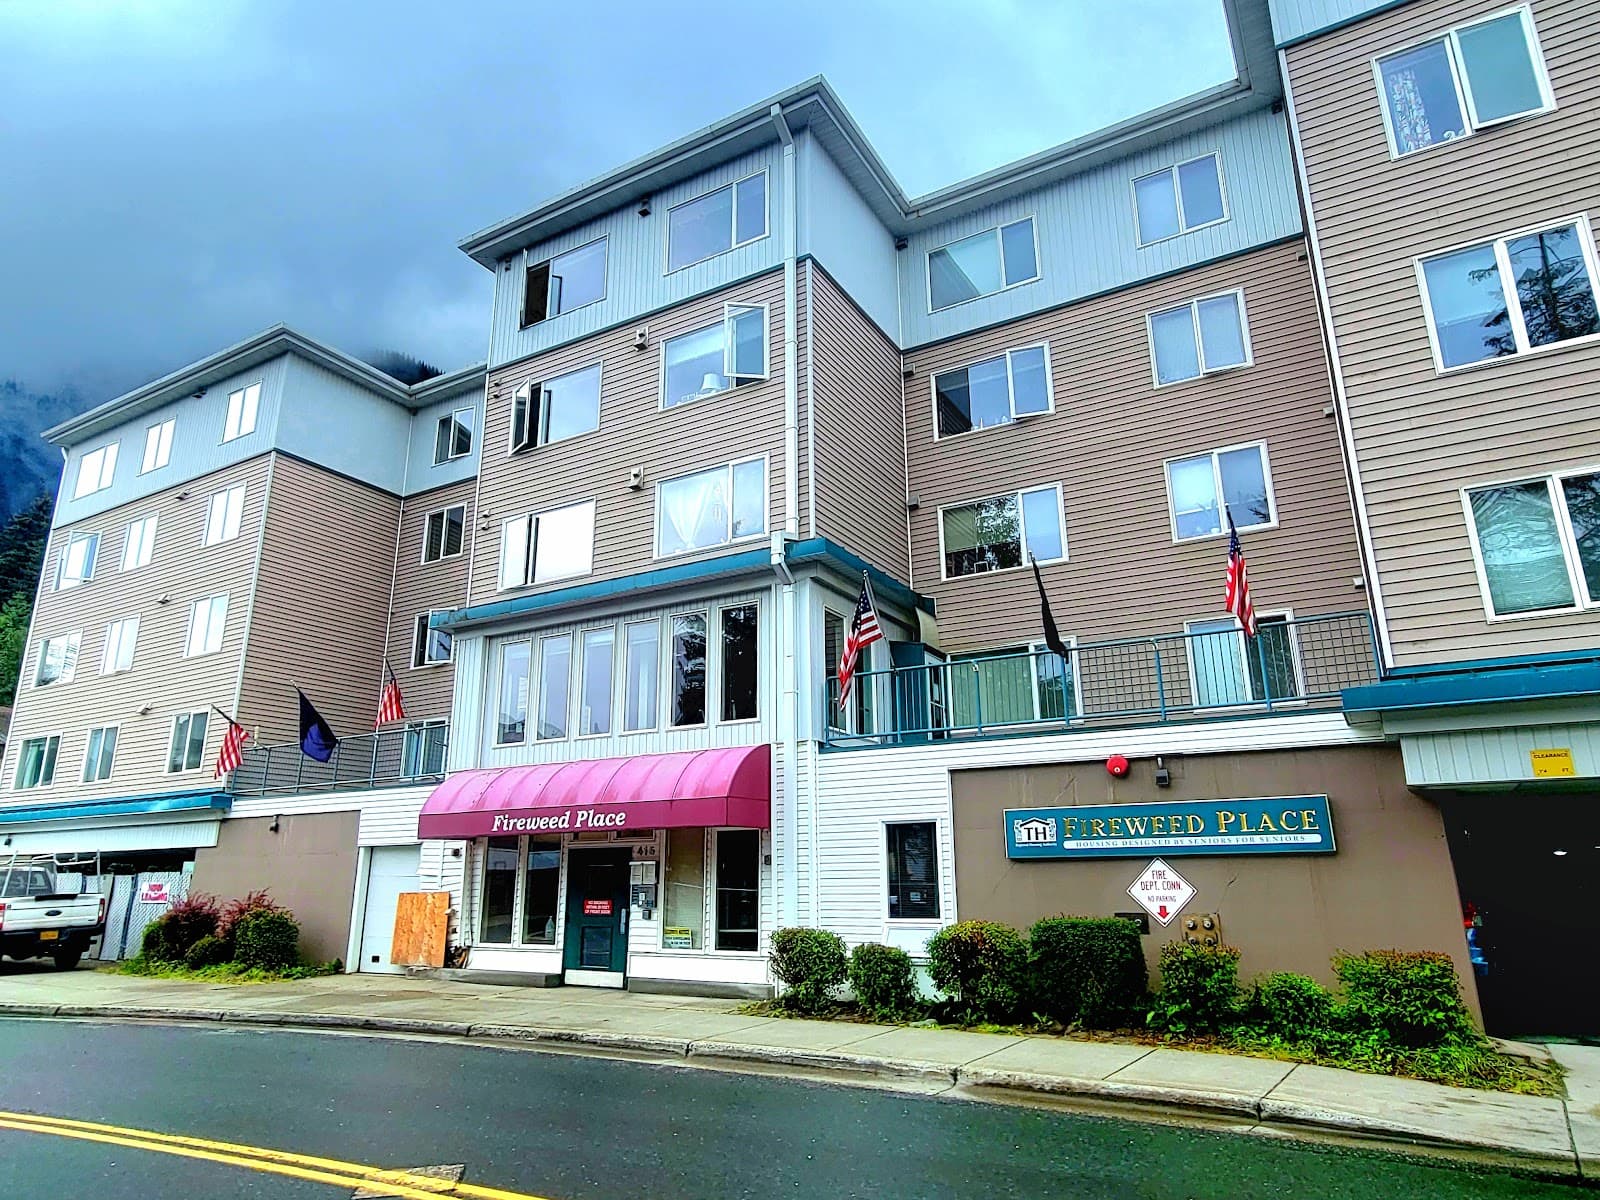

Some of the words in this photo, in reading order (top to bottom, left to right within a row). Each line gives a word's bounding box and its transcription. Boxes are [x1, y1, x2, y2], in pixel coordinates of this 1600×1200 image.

[491, 810, 571, 832] Fireweed
[574, 808, 627, 828] Place
[1062, 813, 1206, 838] FIREWEED
[1215, 809, 1320, 833] PLACE
[1023, 826, 1047, 841] TH
[1075, 840, 1118, 848] HOUSING
[1122, 839, 1171, 847] DESIGNED
[1188, 837, 1233, 845] SENIORS
[1259, 835, 1306, 843] SENIORS
[1151, 870, 1168, 880] FIRE
[1140, 881, 1160, 891] DEPT.
[1162, 881, 1183, 891] CONN.
